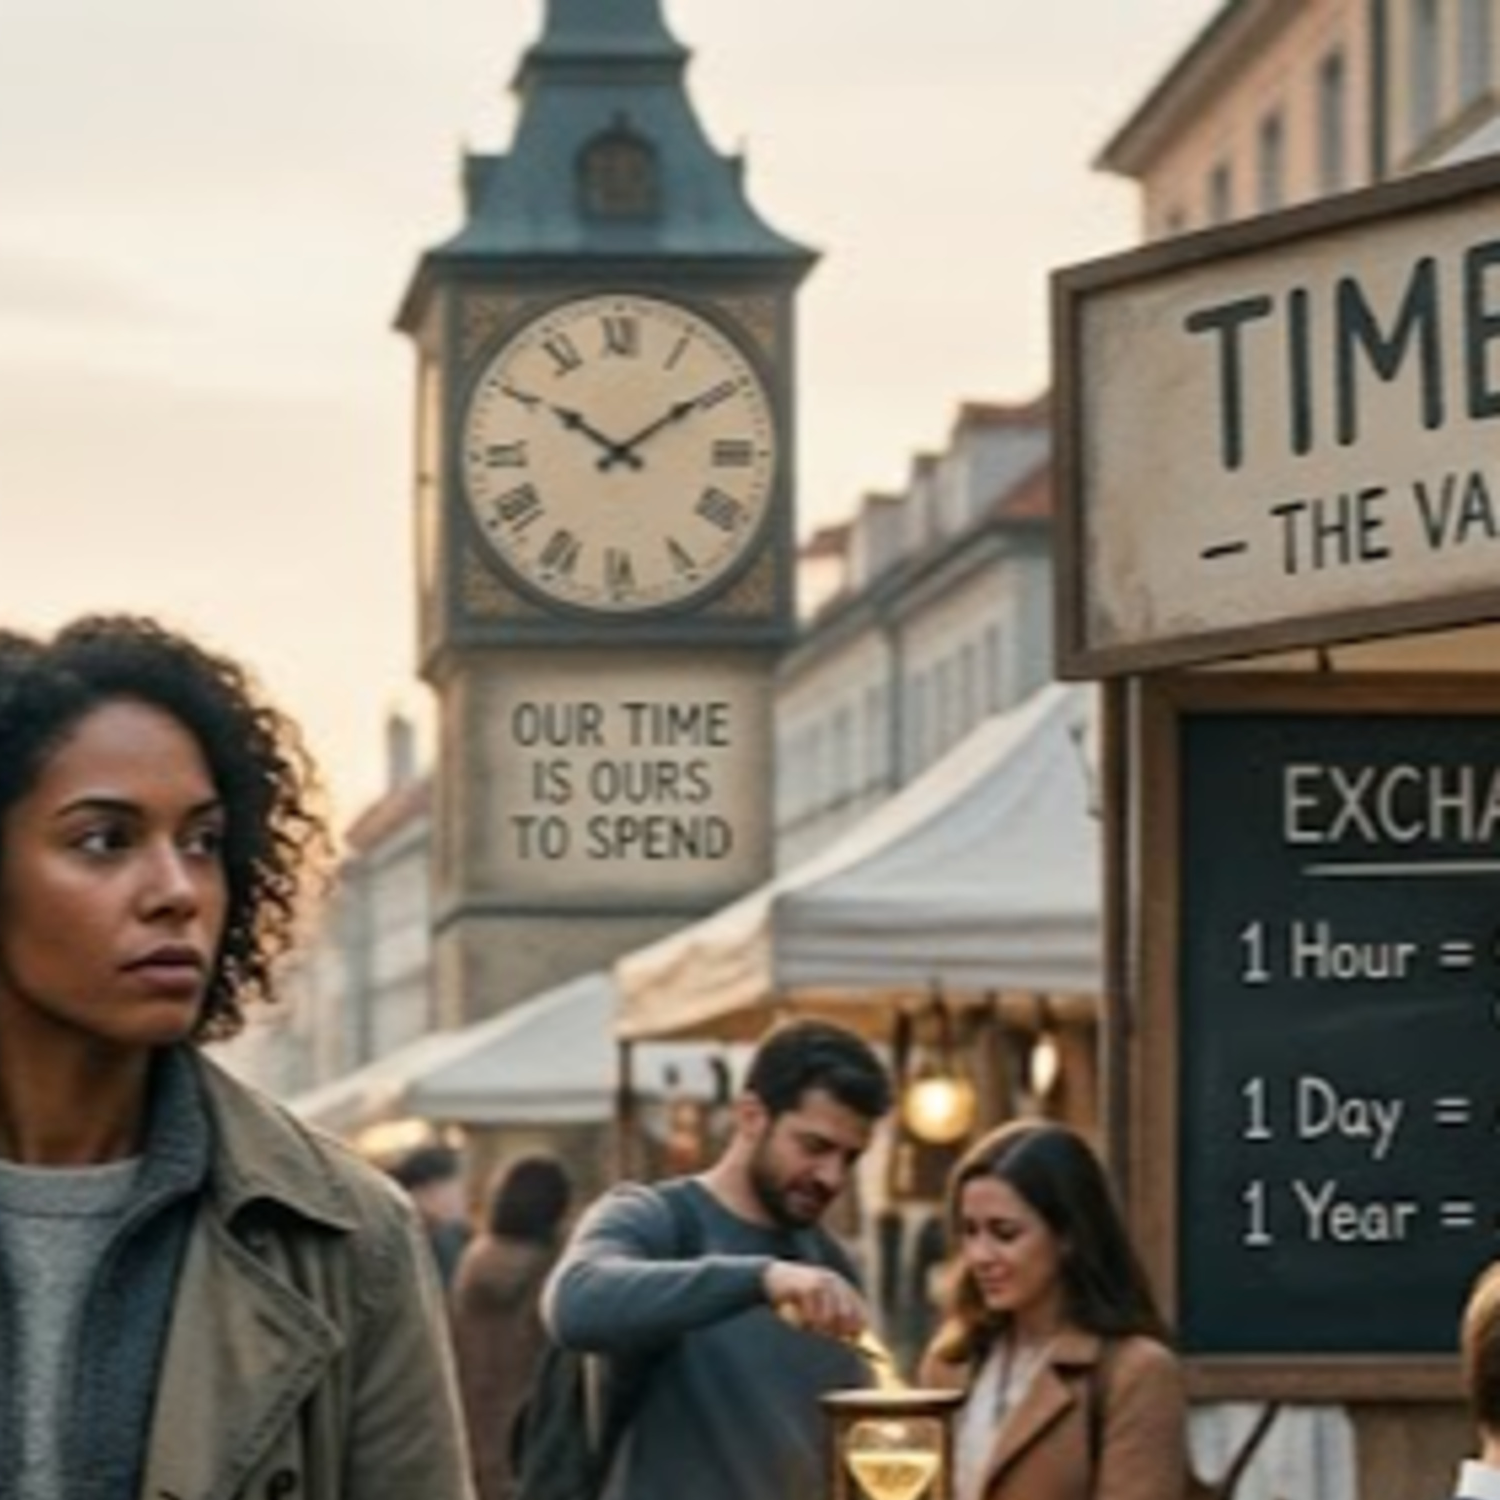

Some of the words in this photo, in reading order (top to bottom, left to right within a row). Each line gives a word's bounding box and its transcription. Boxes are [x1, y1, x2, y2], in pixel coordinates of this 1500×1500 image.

[1270, 486, 1392, 575] THE
[511, 702, 604, 747] OUR
[620, 702, 730, 747] TIME
[532, 758, 574, 805] IS
[589, 758, 712, 805] OURS
[1285, 764, 1500, 842] EXCHA
[509, 814, 570, 860] TO
[586, 814, 734, 860] SPEND
[1239, 921, 1271, 982] 1
[1290, 920, 1417, 979] Hour
[1242, 1076, 1273, 1140] 1
[1297, 1075, 1403, 1160] Day
[1242, 1180, 1273, 1245] 1
[1291, 1179, 1418, 1241] Year
